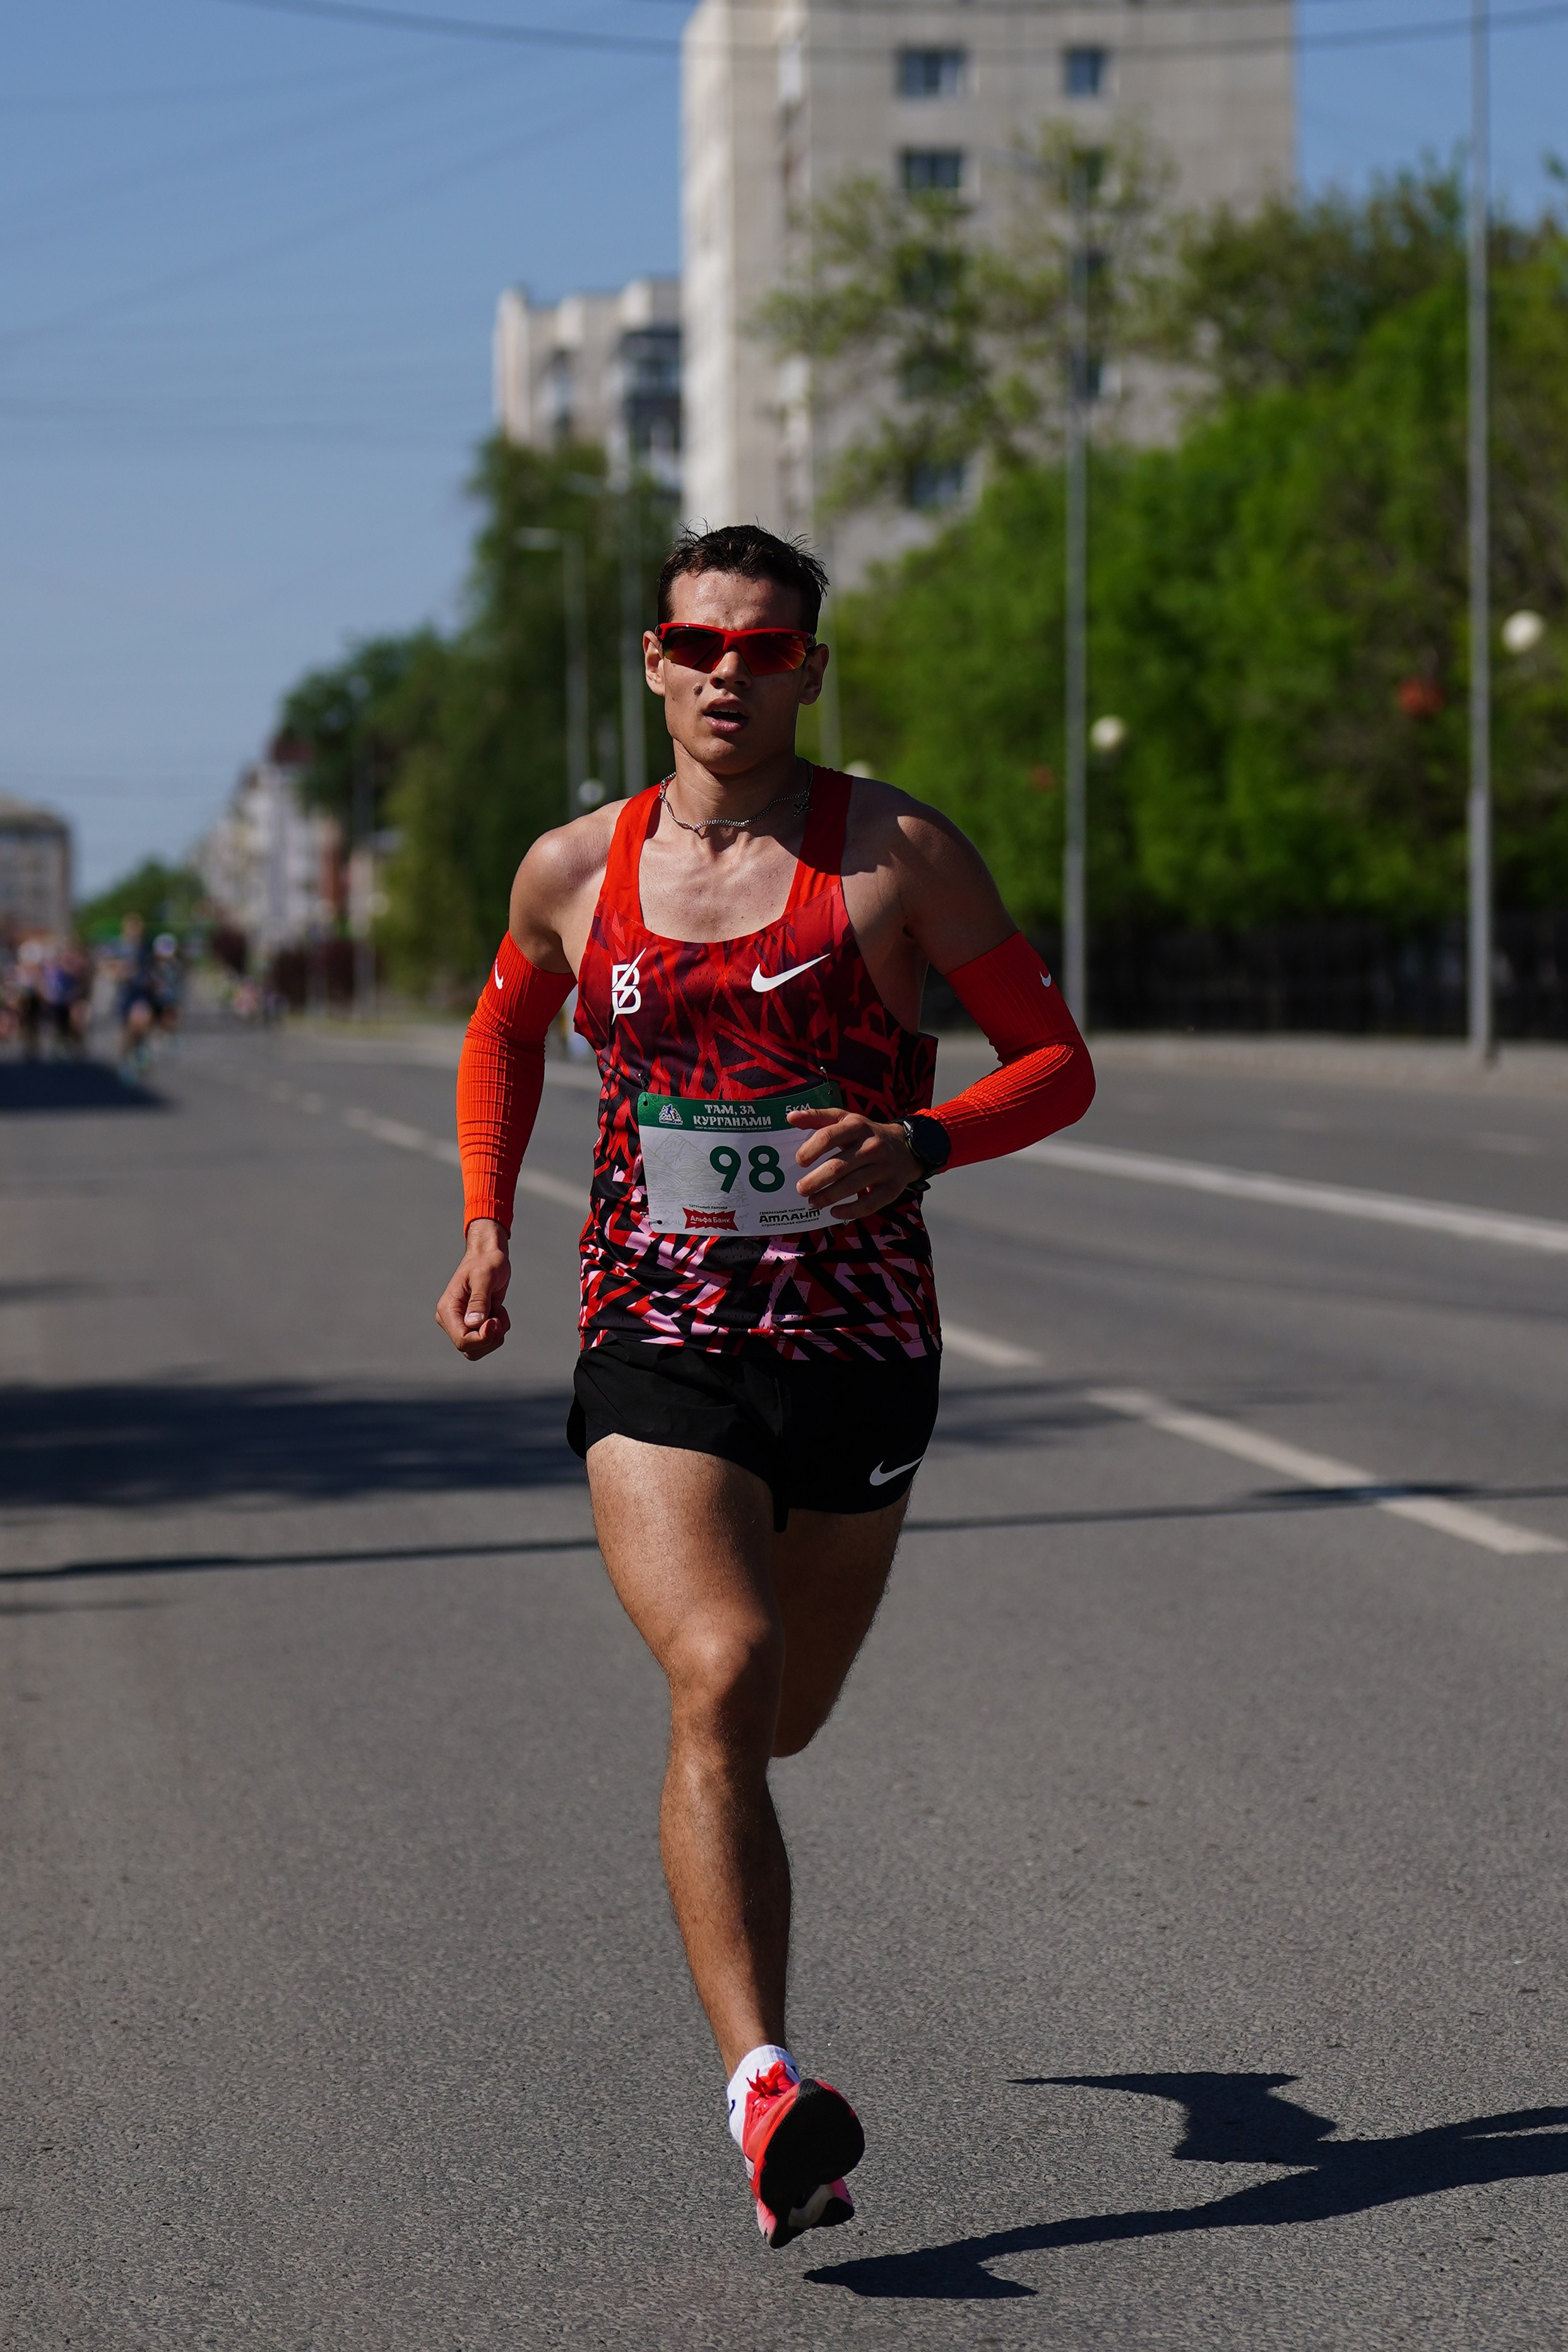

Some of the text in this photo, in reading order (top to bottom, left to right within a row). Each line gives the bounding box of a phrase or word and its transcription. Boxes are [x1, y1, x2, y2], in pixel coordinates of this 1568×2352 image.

[704, 1104, 756, 1116] ТАМ, ЗА
[692, 1115, 772, 1127] КУРГАНАМИ
[710, 1145, 785, 1193] 98
[690, 1215, 712, 1223] Альфа
